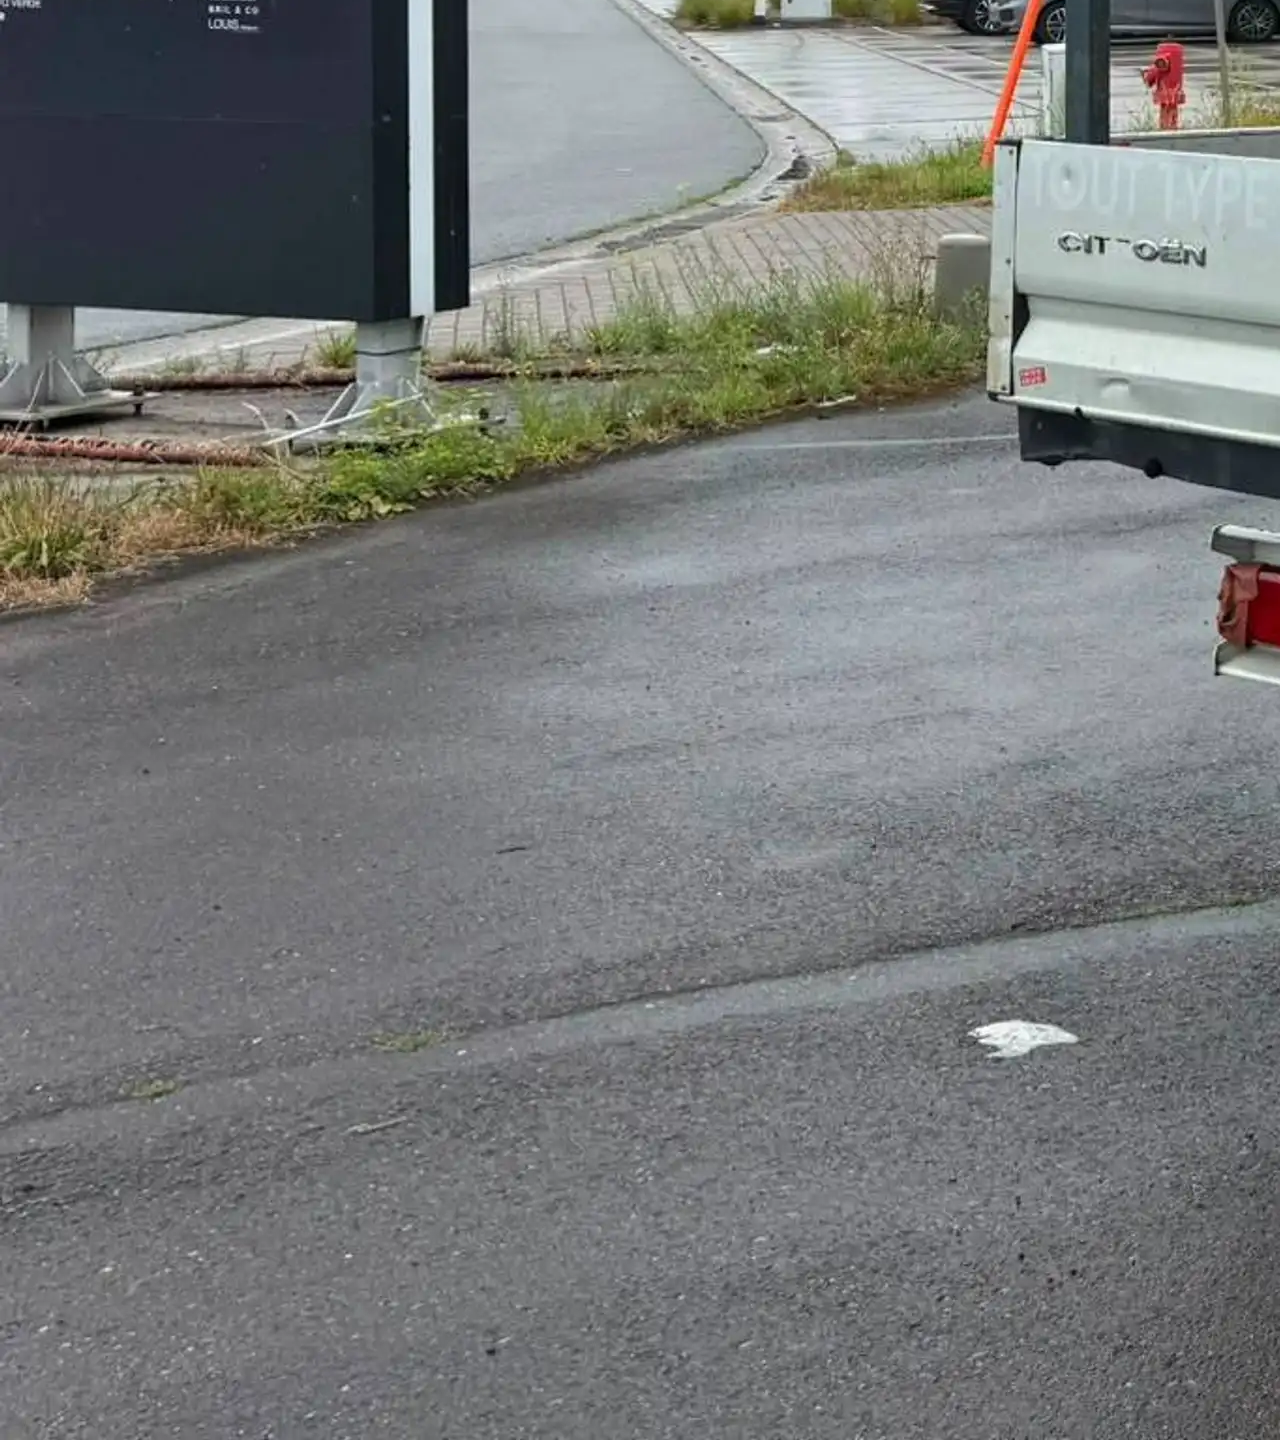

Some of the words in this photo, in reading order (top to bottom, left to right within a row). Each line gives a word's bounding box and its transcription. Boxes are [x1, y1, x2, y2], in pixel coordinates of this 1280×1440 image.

[1032, 152, 1144, 218] TOUT
[1157, 159, 1271, 232] TYPE
[1057, 231, 1208, 268] CITOËN
